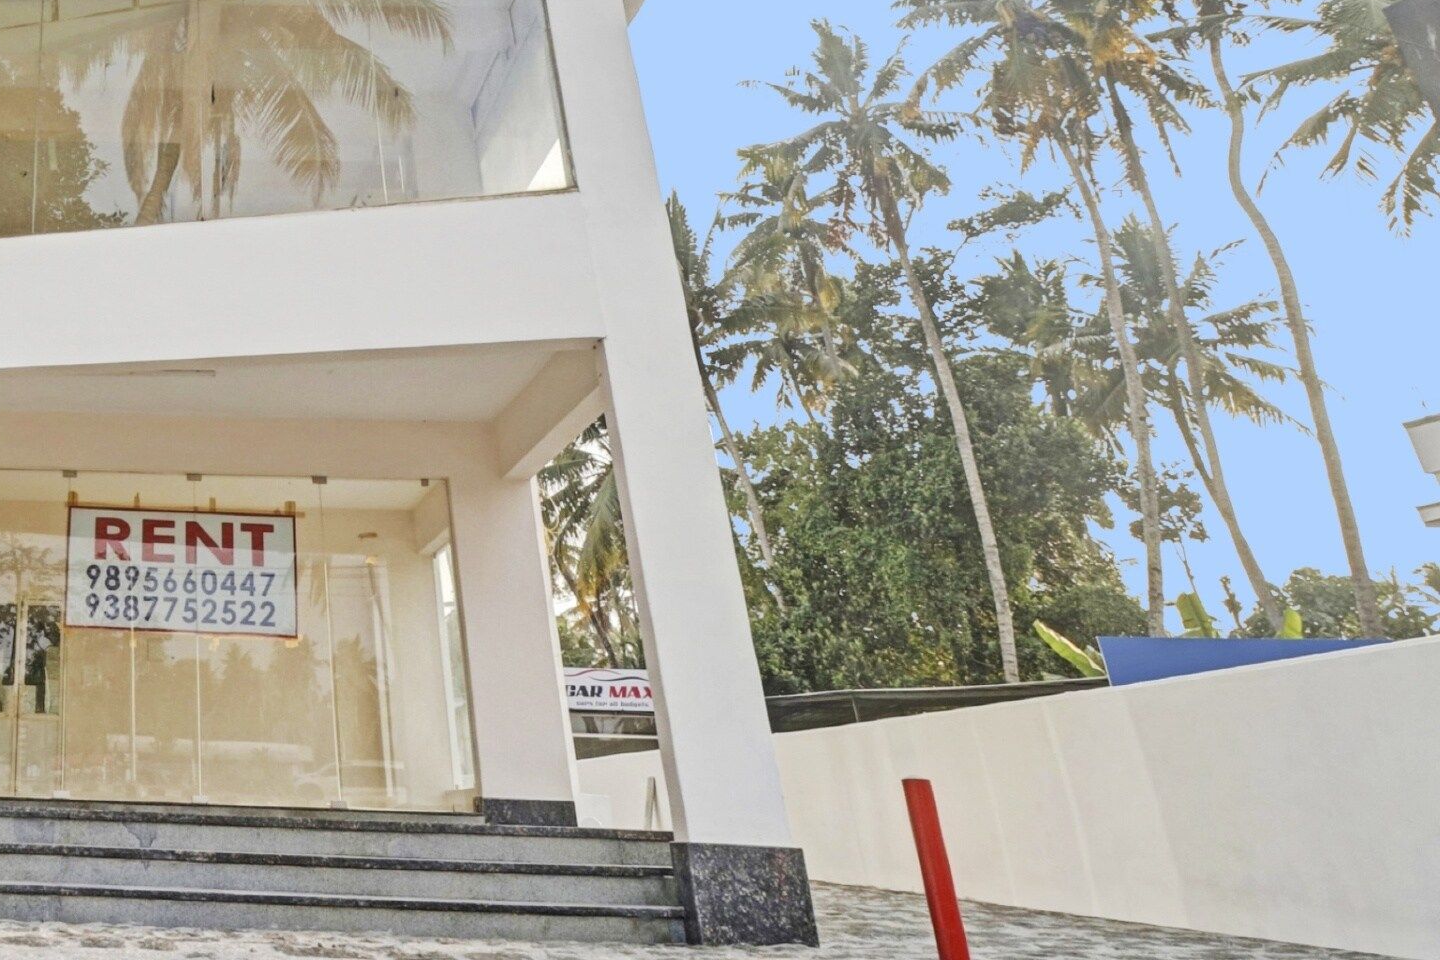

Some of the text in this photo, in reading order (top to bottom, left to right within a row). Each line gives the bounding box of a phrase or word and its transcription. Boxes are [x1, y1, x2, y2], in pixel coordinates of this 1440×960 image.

[94, 516, 275, 567] RENT
[86, 564, 276, 597] 9895660447
[85, 593, 276, 627] 9387752522
